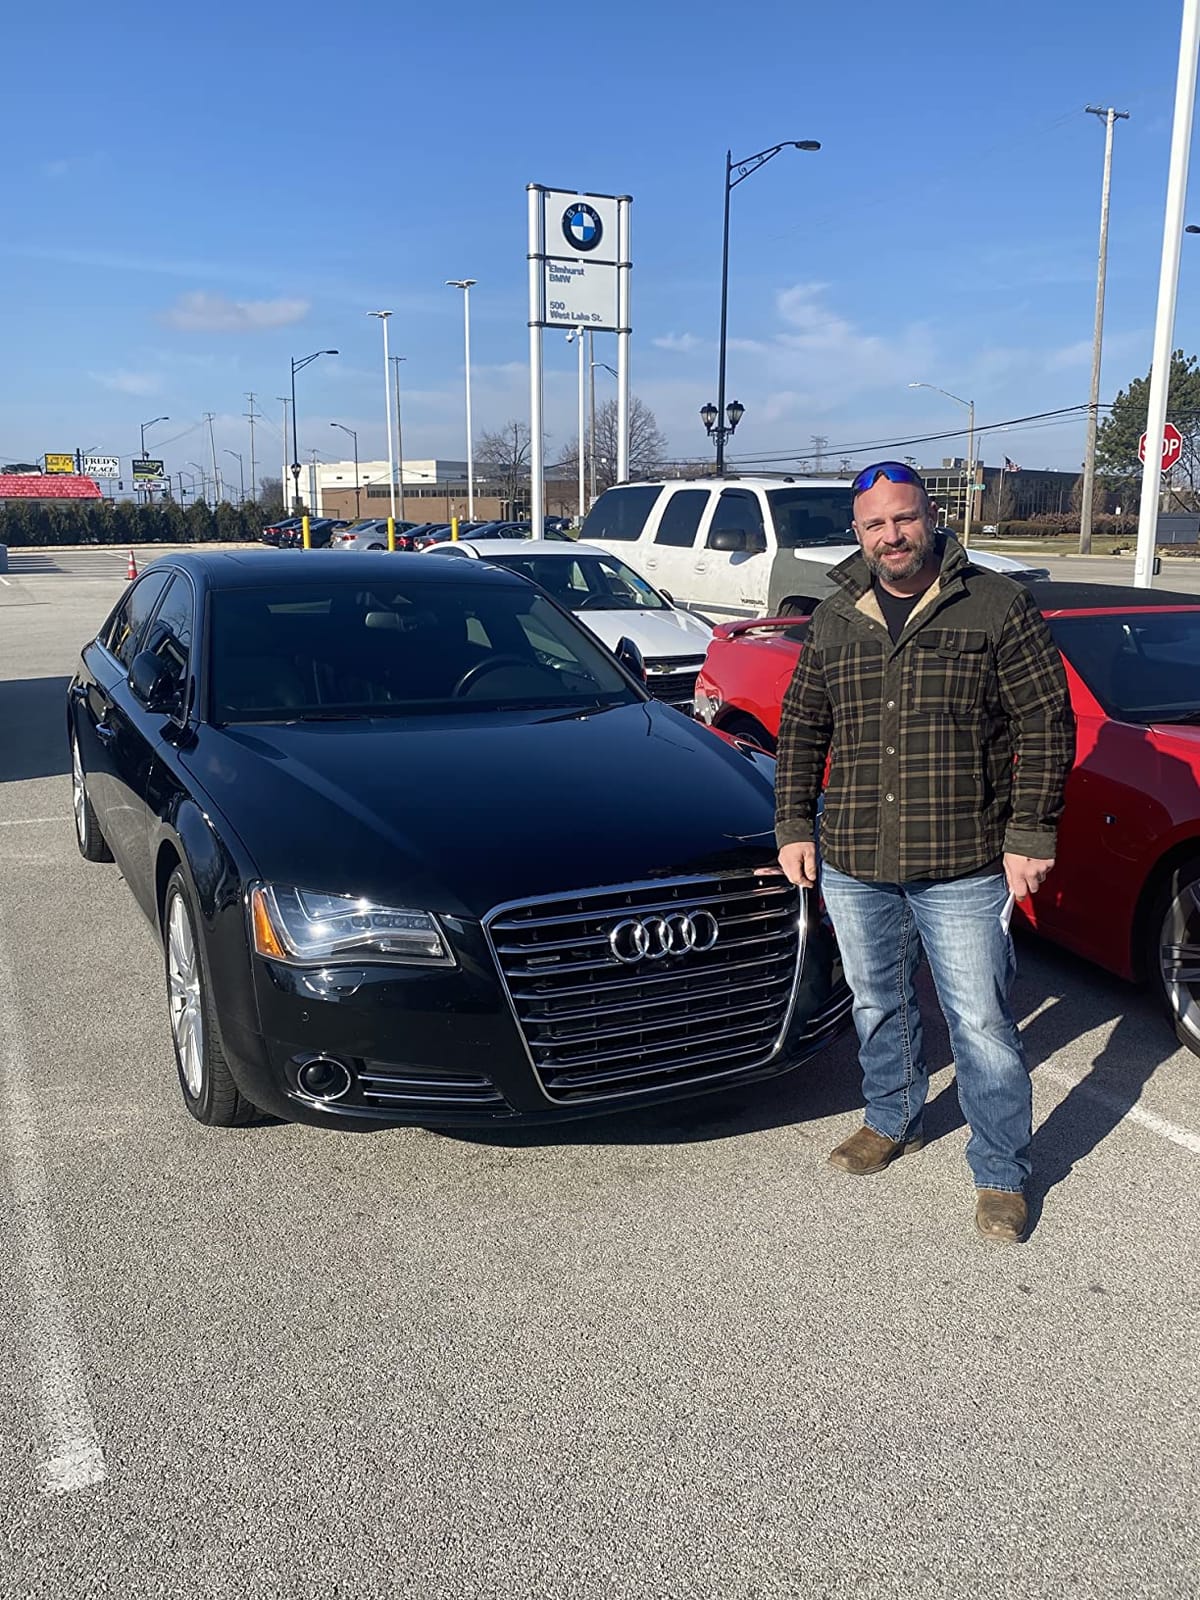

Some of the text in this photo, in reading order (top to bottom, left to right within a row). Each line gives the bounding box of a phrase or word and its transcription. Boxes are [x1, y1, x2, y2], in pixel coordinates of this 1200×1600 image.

[566, 204, 598, 221] BMW
[549, 264, 585, 276] Elmhurst
[549, 274, 571, 283] BMW
[550, 301, 565, 310] 500
[550, 310, 602, 322] West Lake St.
[1142, 439, 1179, 456] SOP
[85, 458, 118, 466] FRED'S
[88, 465, 116, 473] PLACE
